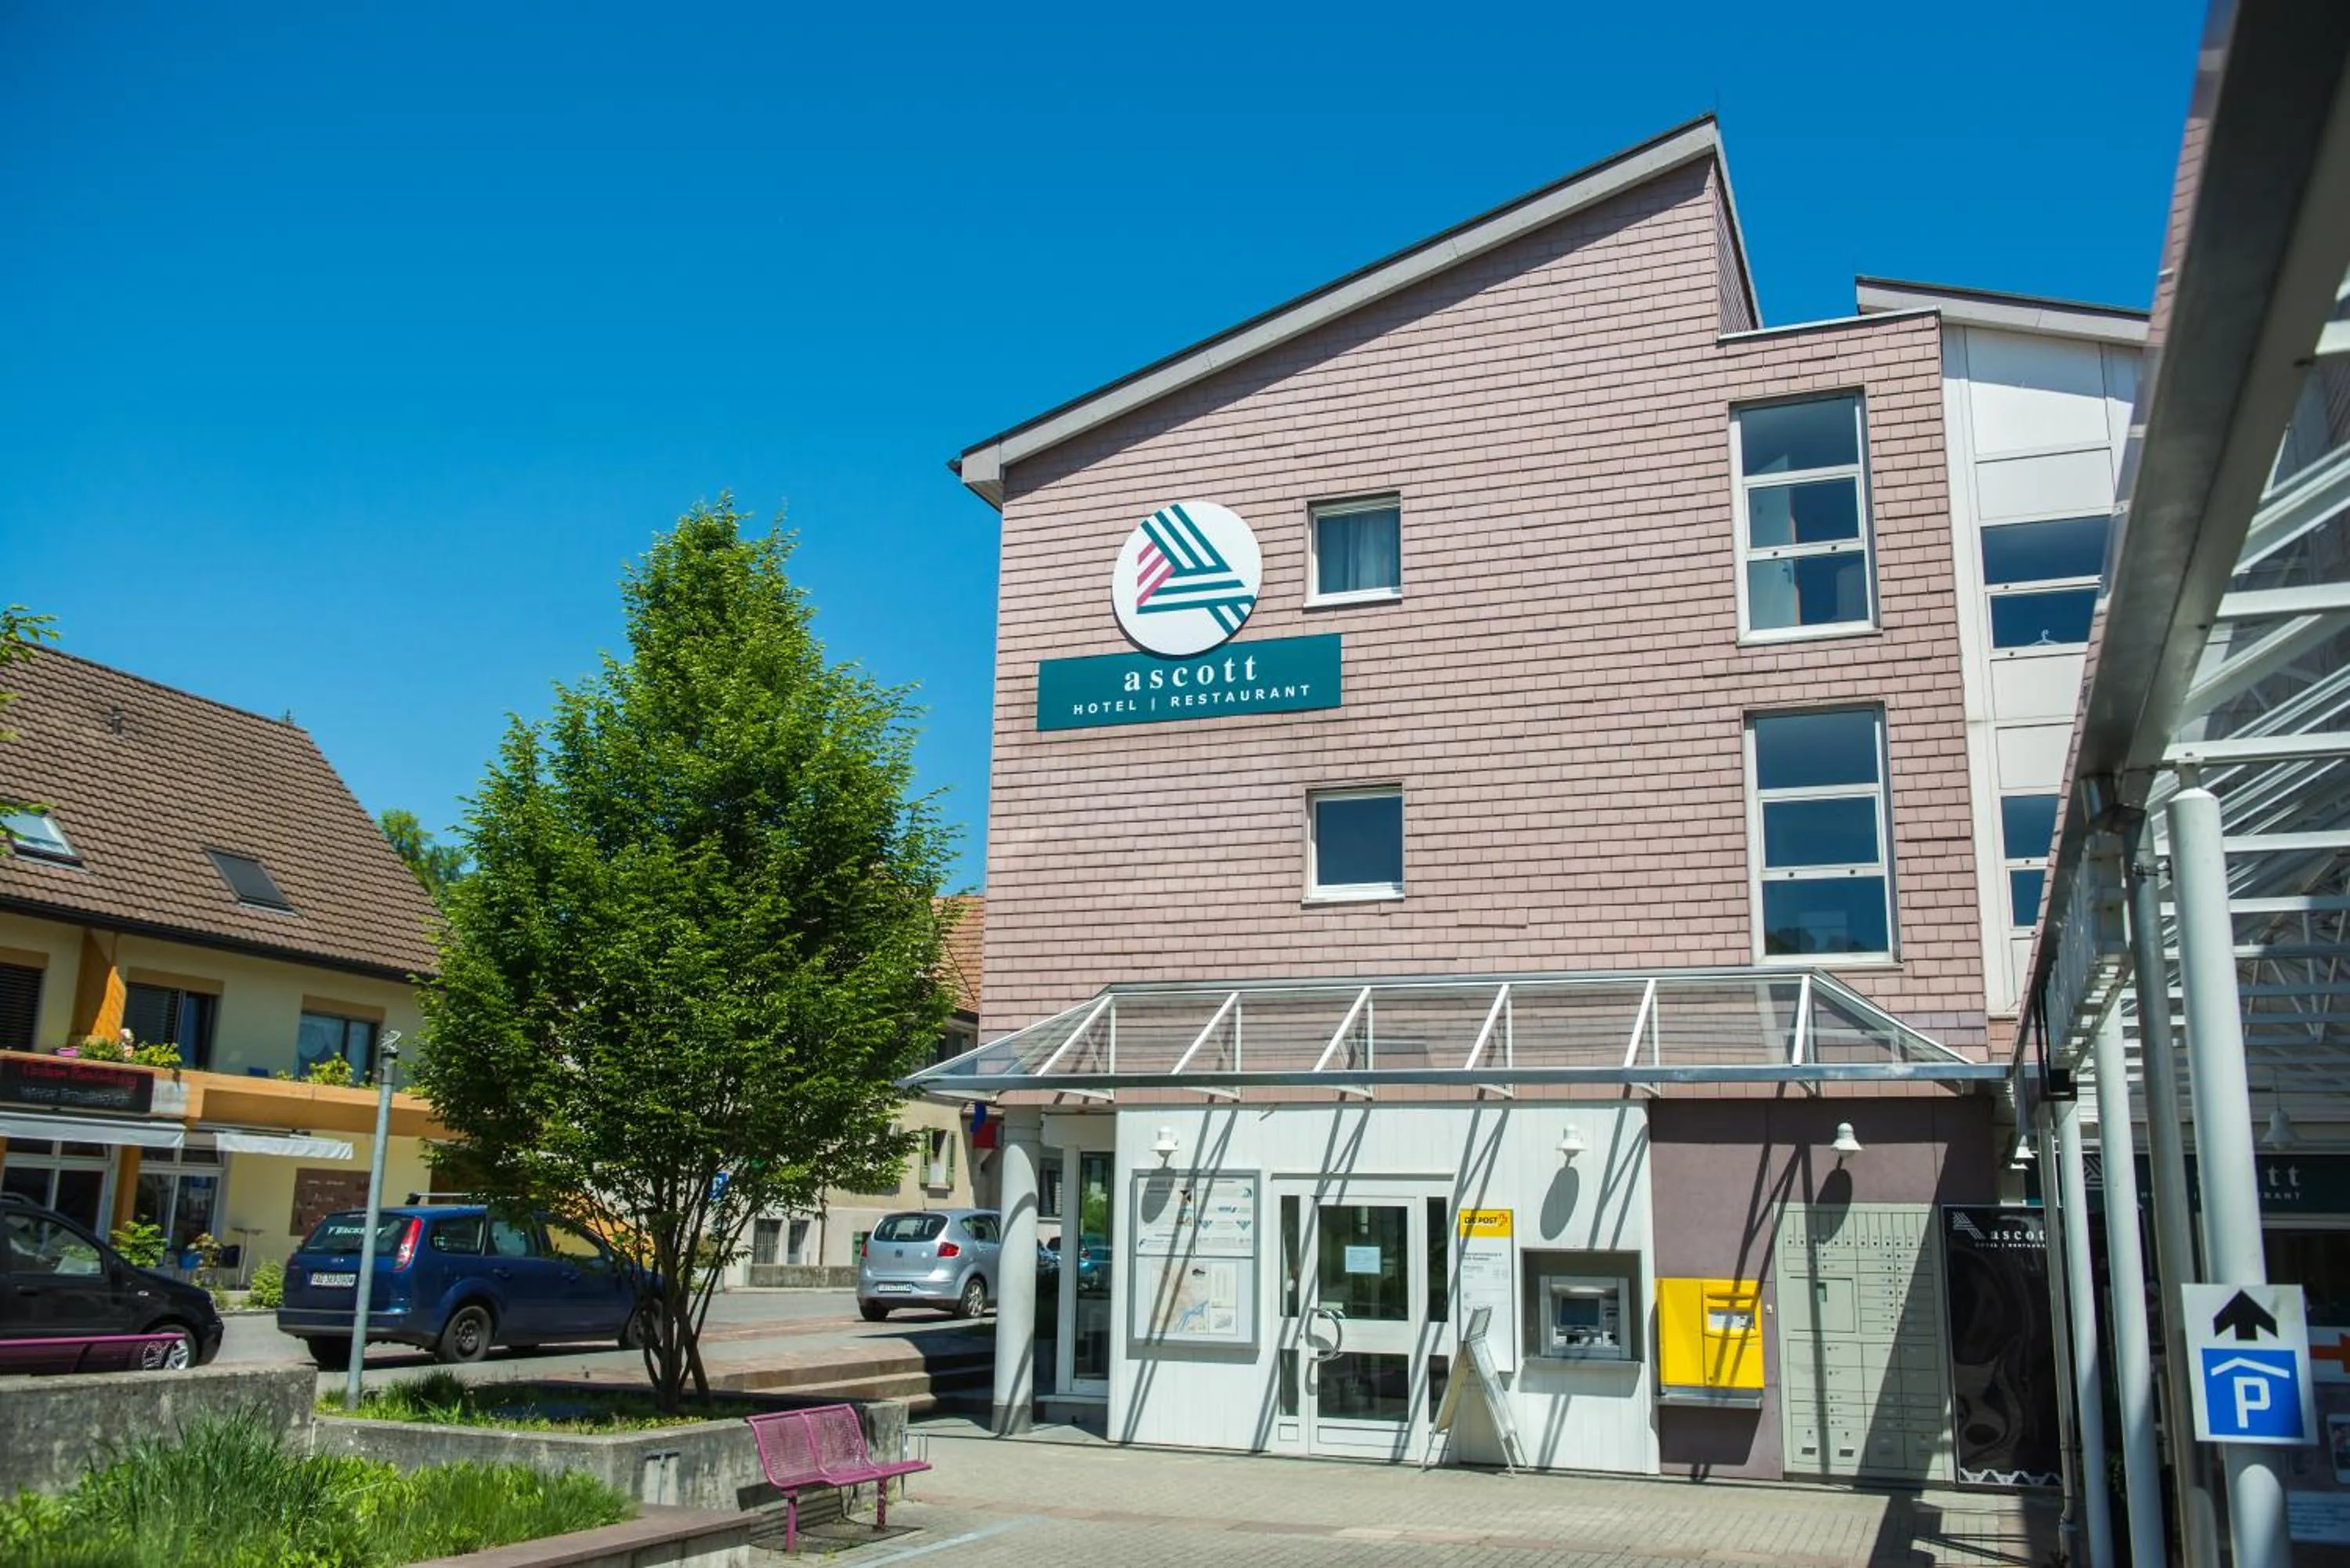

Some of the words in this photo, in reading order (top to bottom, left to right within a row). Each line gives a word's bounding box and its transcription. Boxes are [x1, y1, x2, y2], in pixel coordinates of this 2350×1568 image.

[1123, 655, 1257, 692] ascott
[1072, 699, 1137, 715] HOTEL
[1170, 685, 1311, 707] RESTAURANT
[1990, 1230, 2045, 1241] ascot
[2233, 1376, 2271, 1429] P
